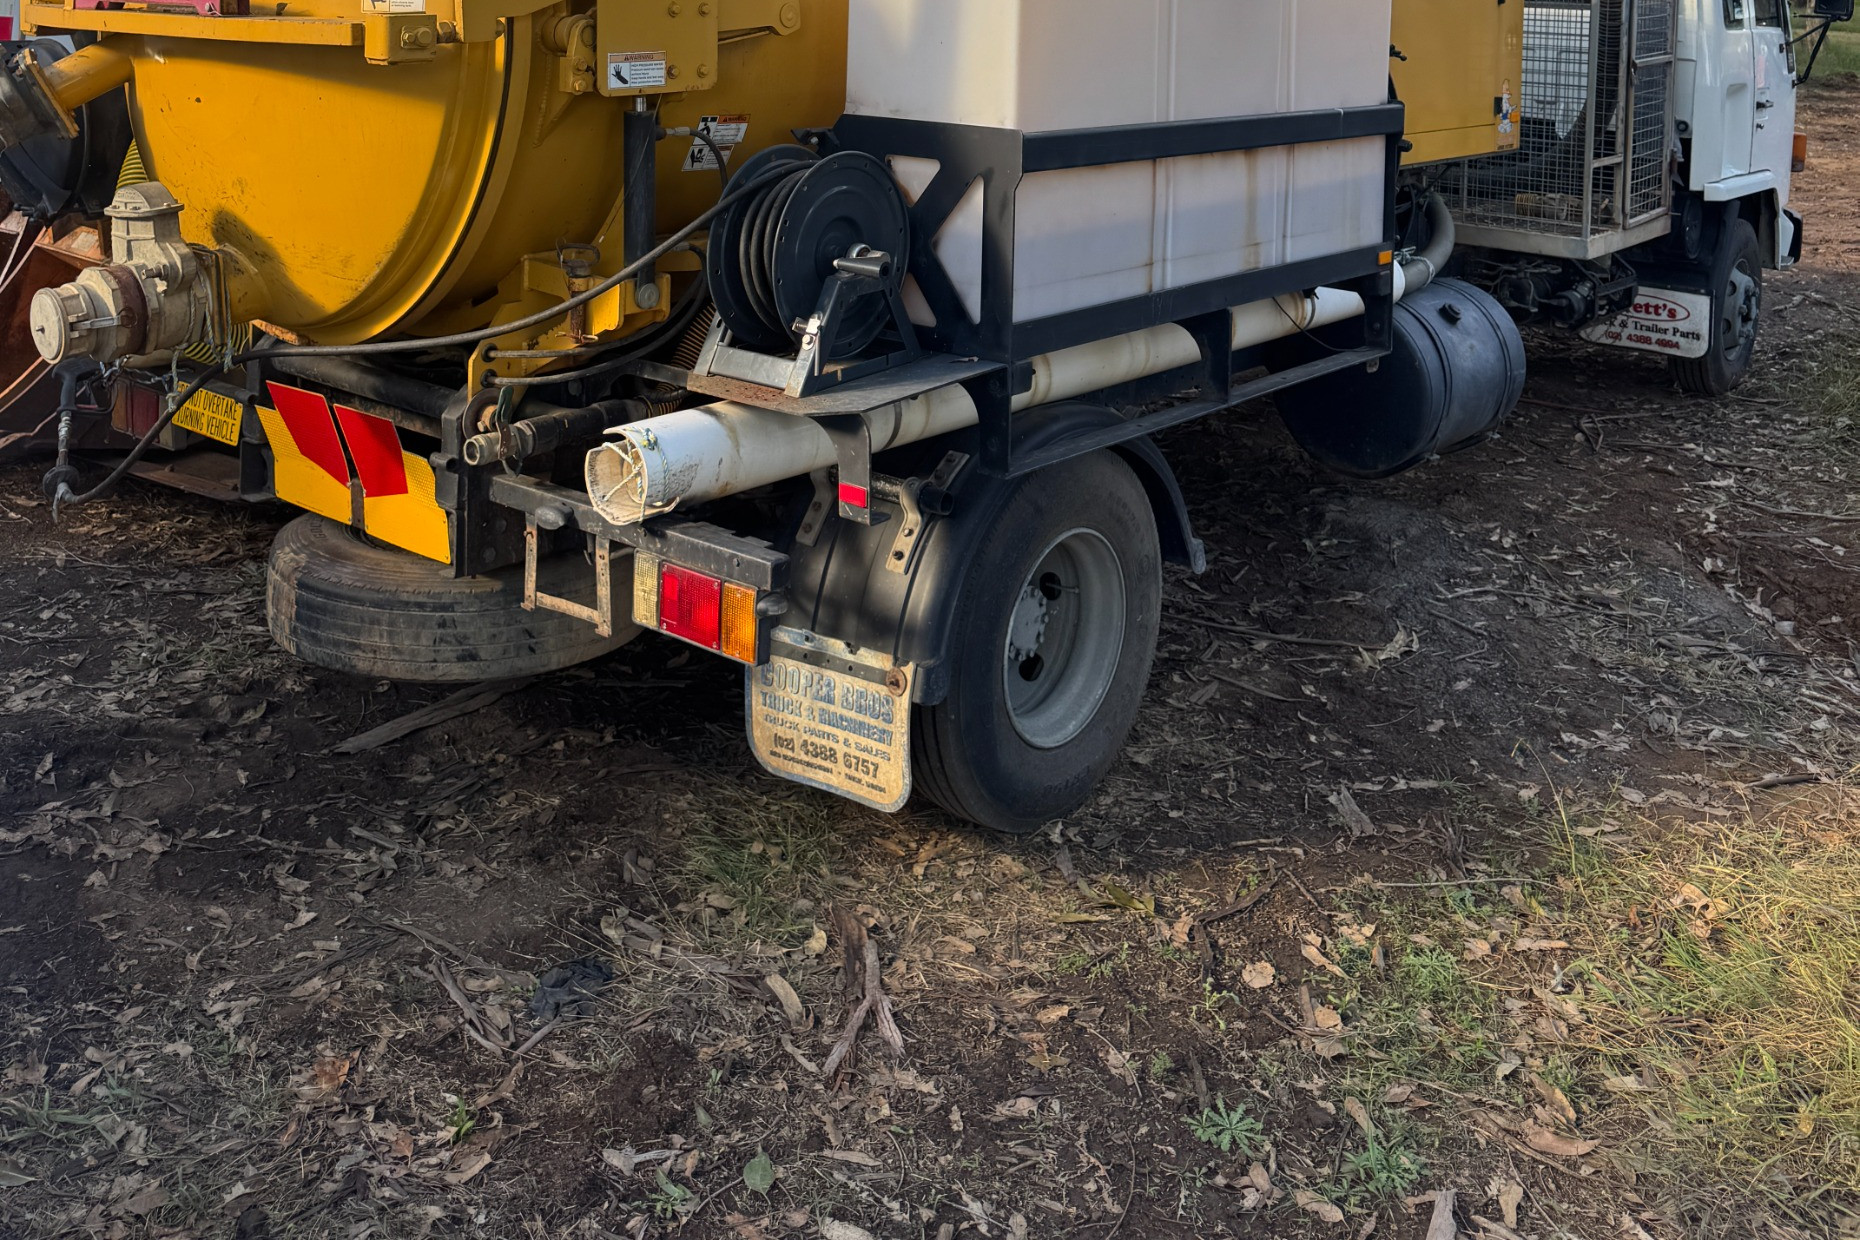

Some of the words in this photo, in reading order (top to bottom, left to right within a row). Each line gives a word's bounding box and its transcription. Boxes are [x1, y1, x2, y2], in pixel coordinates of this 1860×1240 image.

[1632, 301, 1677, 320] ett's
[1632, 320, 1669, 335] Trailer
[1672, 327, 1701, 341] Parts
[202, 391, 237, 421] OVERTAKE
[206, 414, 236, 442] VEHICLE
[760, 660, 836, 705] COOPER
[841, 680, 894, 724] BROS
[760, 690, 803, 718] TRUCK
[818, 707, 893, 746] MACHINERY
[764, 713, 800, 733] TRUCK
[803, 725, 839, 744] PARTS
[773, 732, 796, 754] (02)
[800, 739, 838, 764] 4388
[843, 751, 880, 779] 6757
